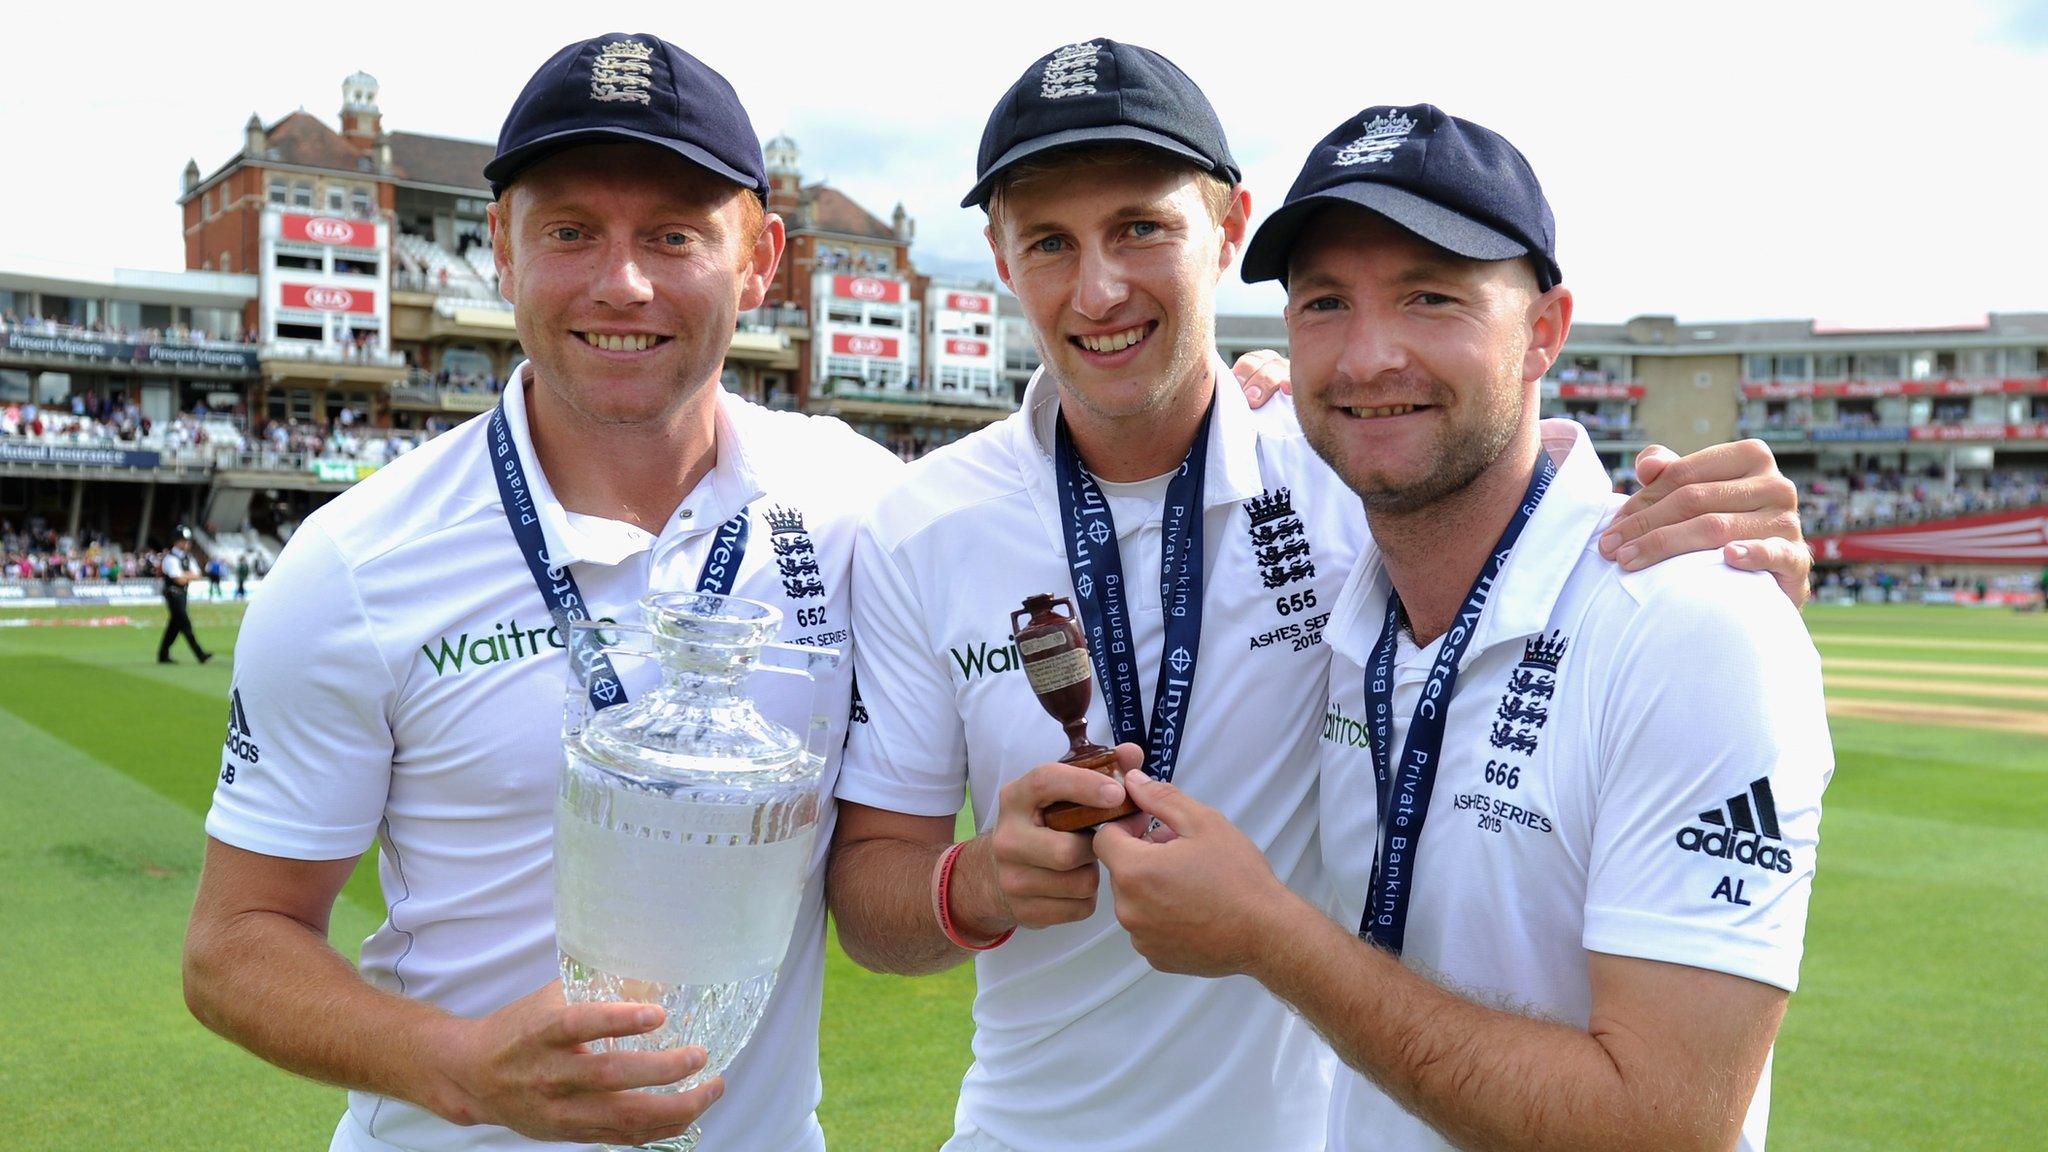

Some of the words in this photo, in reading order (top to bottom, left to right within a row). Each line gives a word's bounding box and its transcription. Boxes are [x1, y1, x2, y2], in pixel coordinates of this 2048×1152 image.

[505, 459, 537, 526] Private
[797, 605, 827, 628] 652
[1105, 574, 1126, 655] Banking
[1276, 588, 1317, 616] 655
[817, 629, 847, 647] SERIES
[1250, 624, 1302, 651] ASHES
[1292, 631, 1323, 652] 2015
[1372, 610, 1396, 693] Banking
[1420, 574, 1495, 720] Investec
[1117, 661, 1137, 733] Private
[1375, 702, 1387, 781] Private
[1396, 749, 1428, 827] Private
[1485, 759, 1521, 790] 666
[1453, 794, 1490, 812] ASHES
[1492, 799, 1552, 833] SERIES
[1477, 813, 1502, 833] 2015
[1675, 826, 1793, 874] adidas
[1377, 836, 1407, 926] Banking
[1711, 876, 1751, 906] AL
